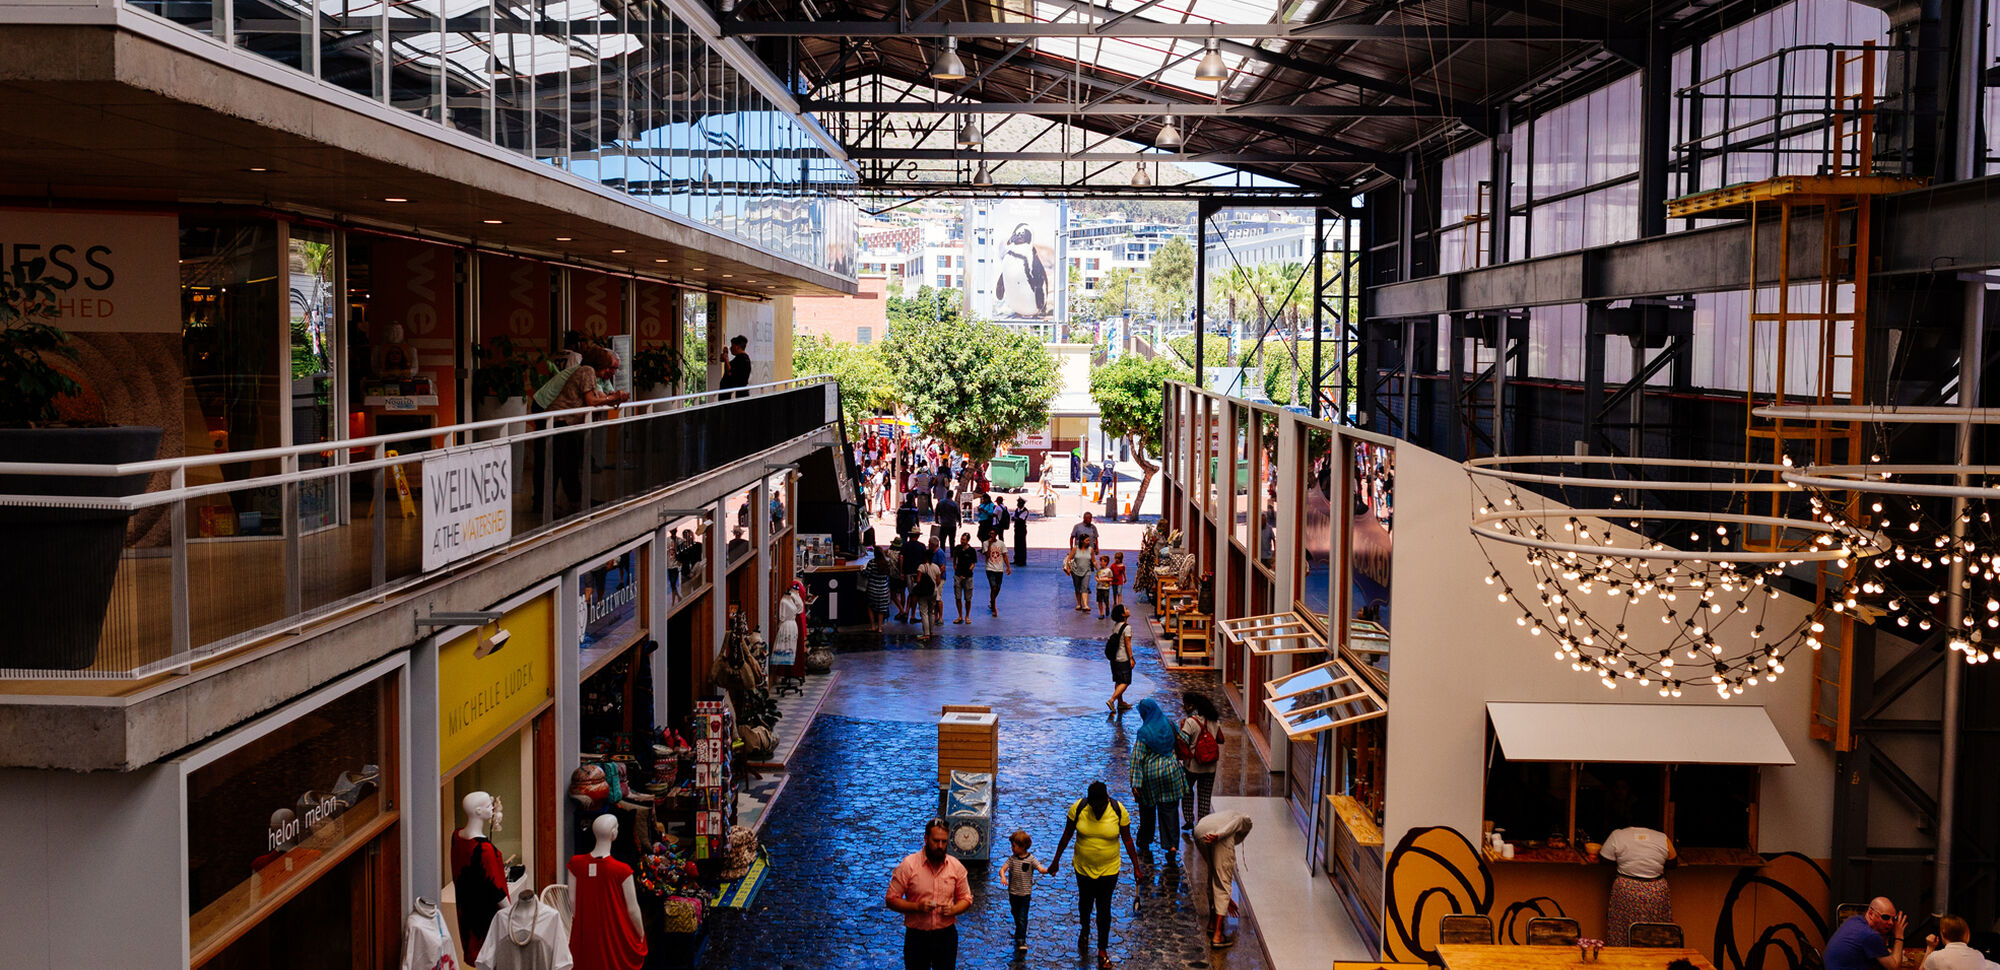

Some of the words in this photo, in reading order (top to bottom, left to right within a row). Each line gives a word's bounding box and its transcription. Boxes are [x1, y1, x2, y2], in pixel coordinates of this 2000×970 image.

[0, 243, 115, 291] ESS
[431, 460, 508, 517] WELLNESS
[590, 572, 638, 624] heartworks
[449, 681, 502, 737] MICHELLE
[504, 660, 535, 700] LUDEK
[268, 817, 300, 852] helon
[304, 794, 338, 830] melon
